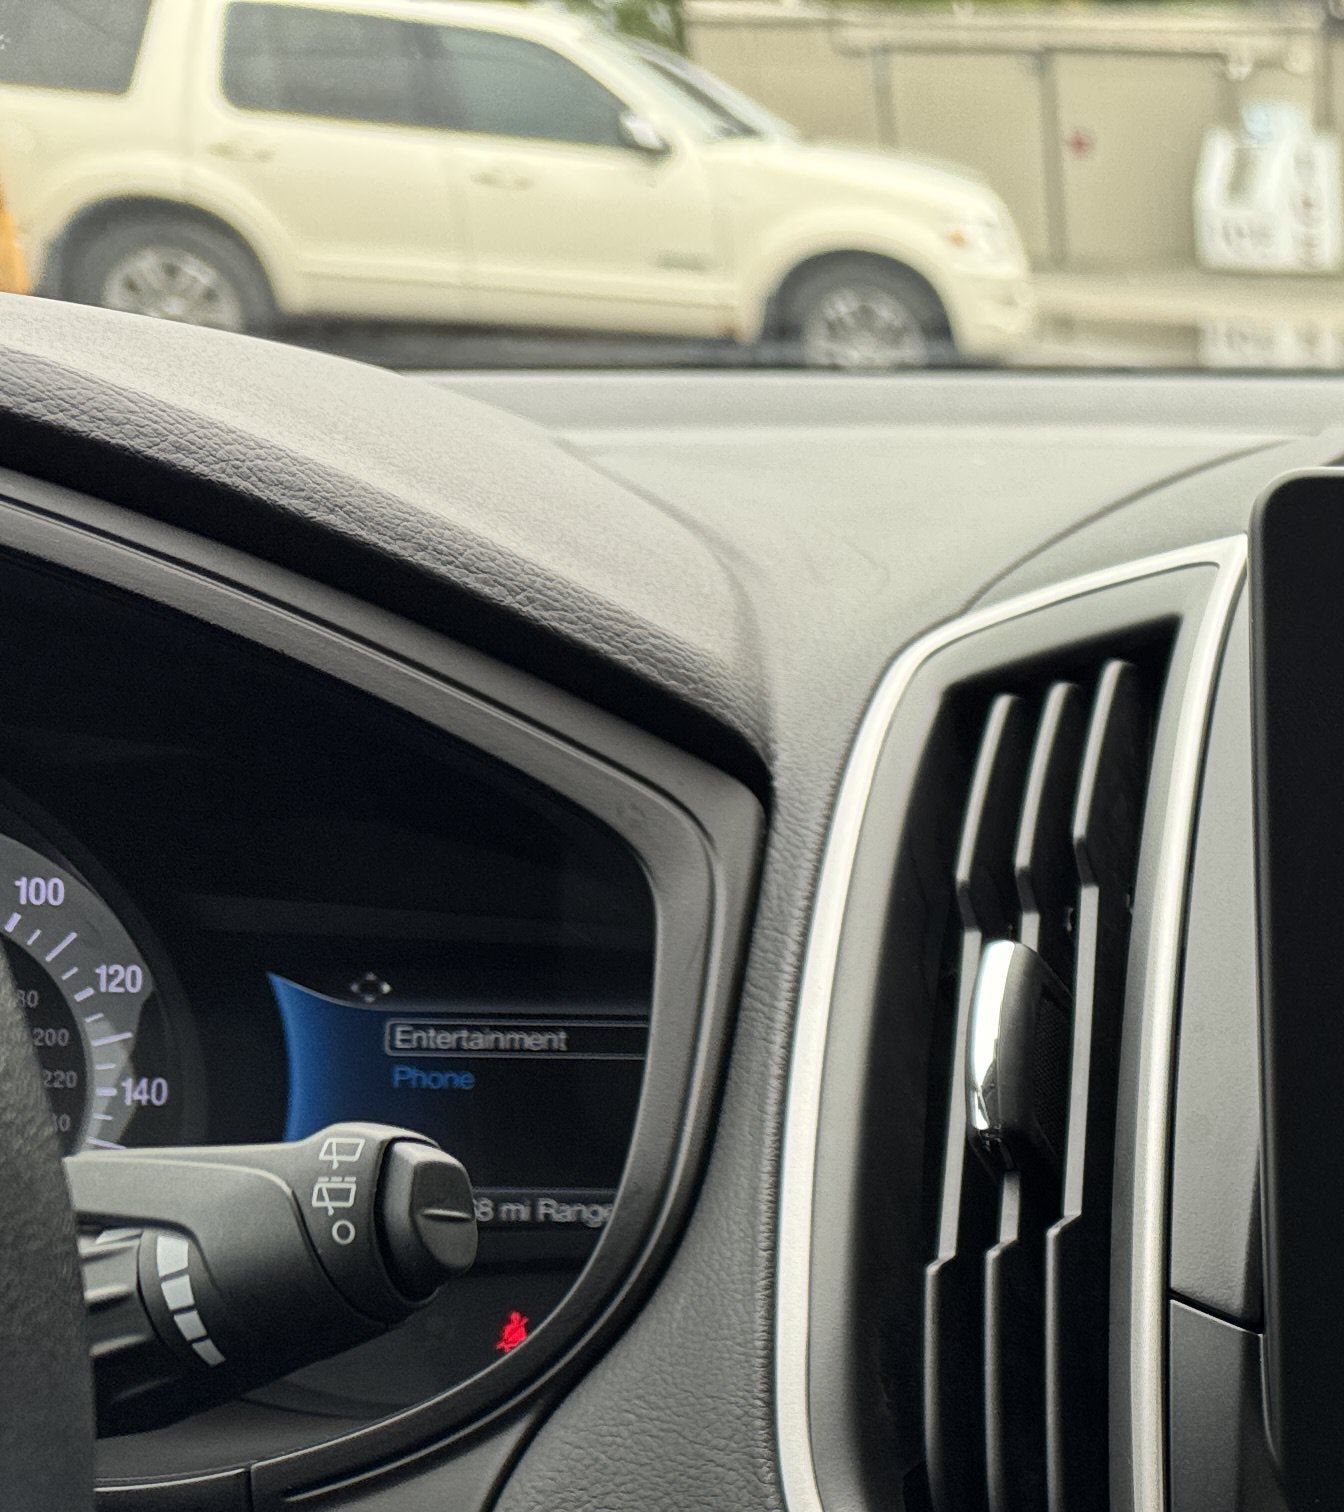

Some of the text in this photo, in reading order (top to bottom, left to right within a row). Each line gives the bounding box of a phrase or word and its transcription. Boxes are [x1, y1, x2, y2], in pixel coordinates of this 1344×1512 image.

[15, 877, 64, 905] 100
[95, 964, 143, 994] 120
[32, 1028, 69, 1046] 200
[395, 1026, 568, 1051] Entertainment
[392, 1066, 475, 1090] Phone
[122, 1077, 168, 1106] 140
[498, 1198, 531, 1222] mi
